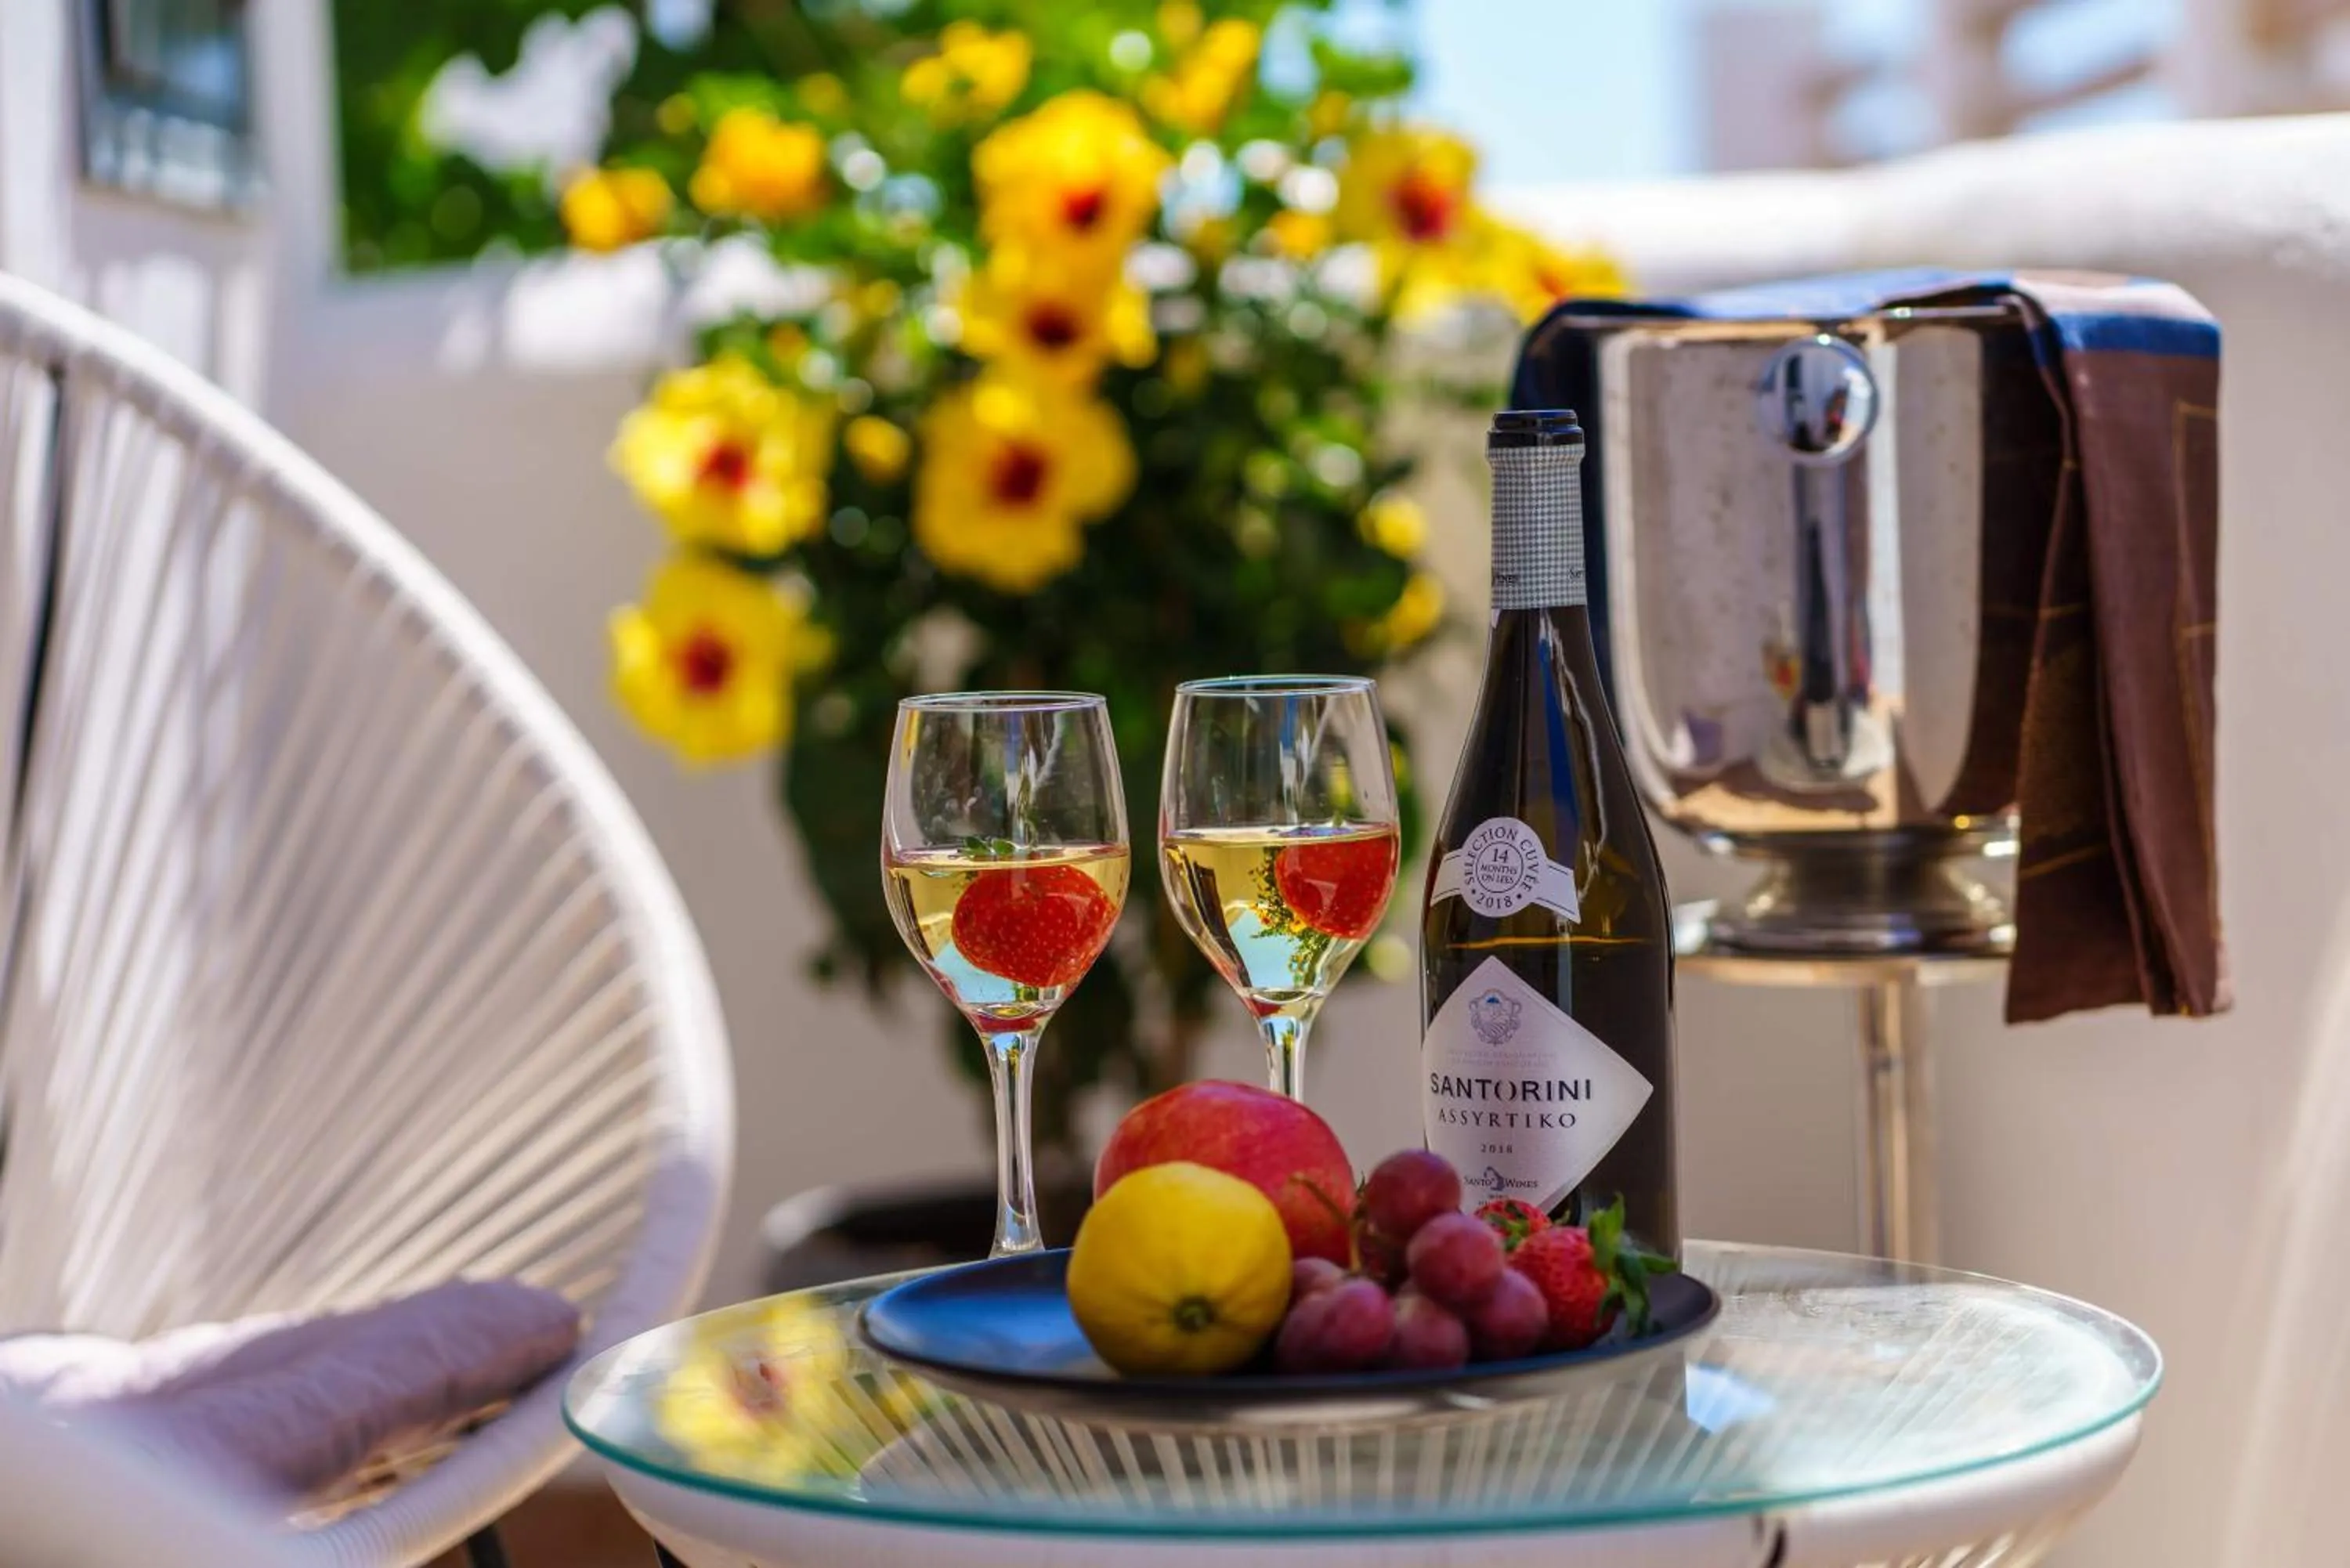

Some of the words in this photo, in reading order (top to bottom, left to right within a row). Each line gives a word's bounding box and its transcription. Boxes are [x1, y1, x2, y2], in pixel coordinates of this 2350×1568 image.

[1463, 826, 1518, 885] SELECTION
[1491, 848, 1508, 863] 14
[1476, 893, 1513, 909] 2018
[1430, 1072, 1592, 1102] SANTORINI
[1438, 1108, 1577, 1129] ASSYRTIKO
